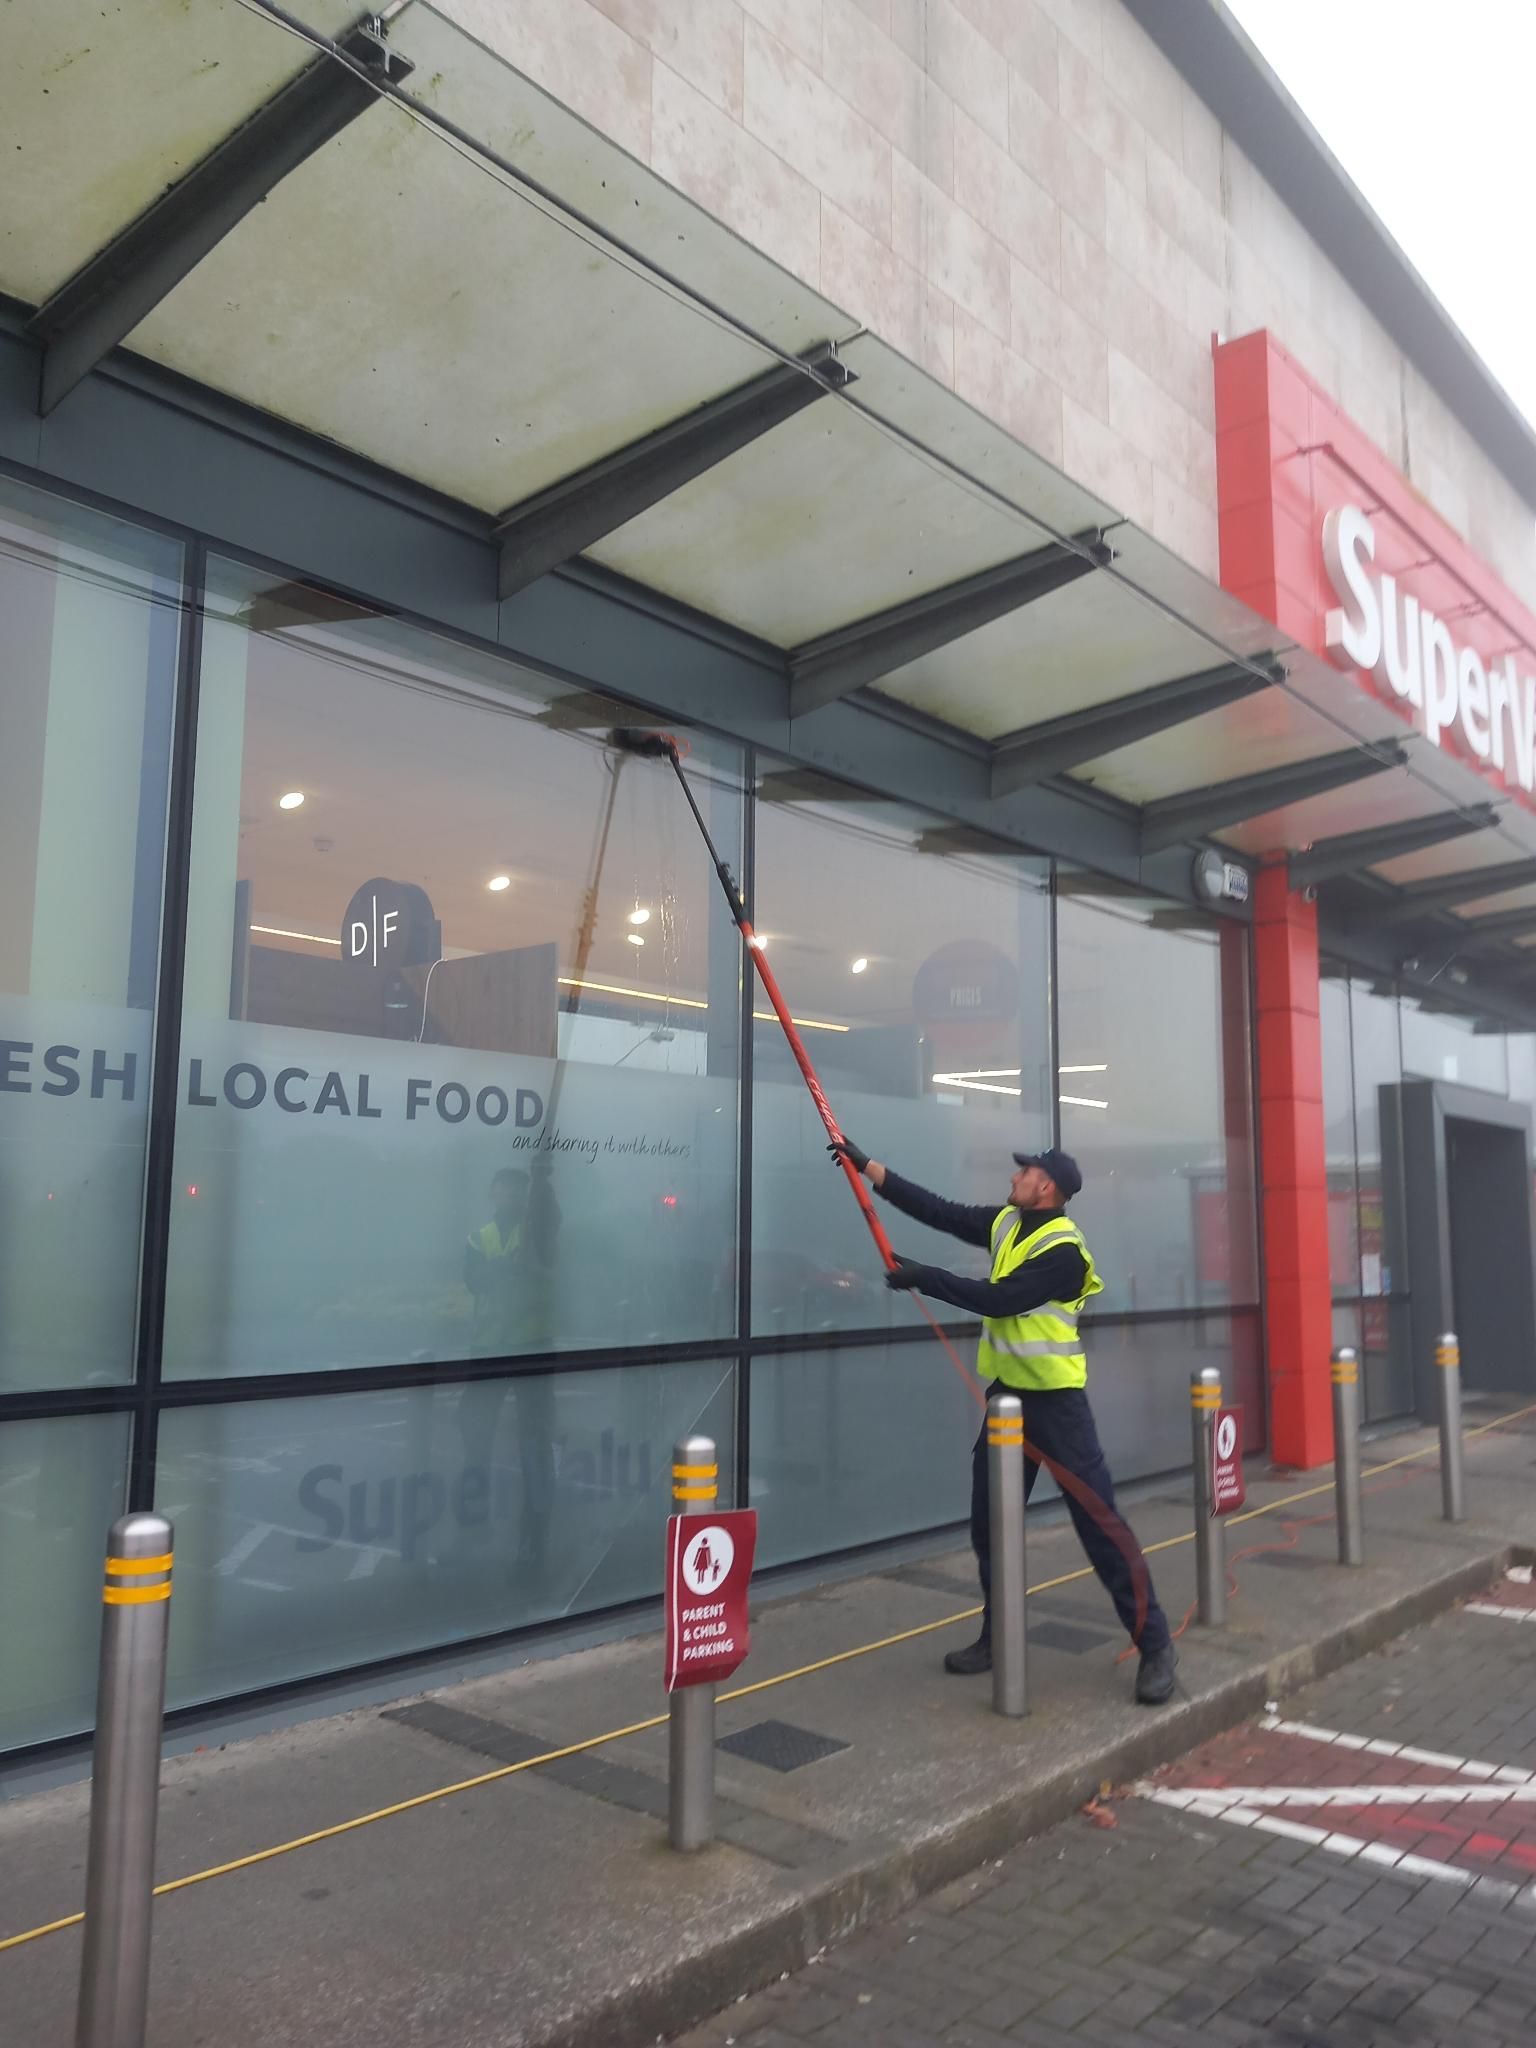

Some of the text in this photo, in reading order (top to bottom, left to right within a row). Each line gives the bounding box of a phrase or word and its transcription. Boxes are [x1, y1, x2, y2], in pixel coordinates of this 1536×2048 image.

[1322, 505, 1536, 793] SuperV
[0, 1039, 544, 1128] ESH LOCAL FOOD
[512, 1126, 546, 1150] and
[547, 1127, 600, 1164] sharing
[682, 1602, 725, 1623] PARENT
[683, 1621, 727, 1642] & CHILD
[683, 1638, 734, 1661] PARKING
